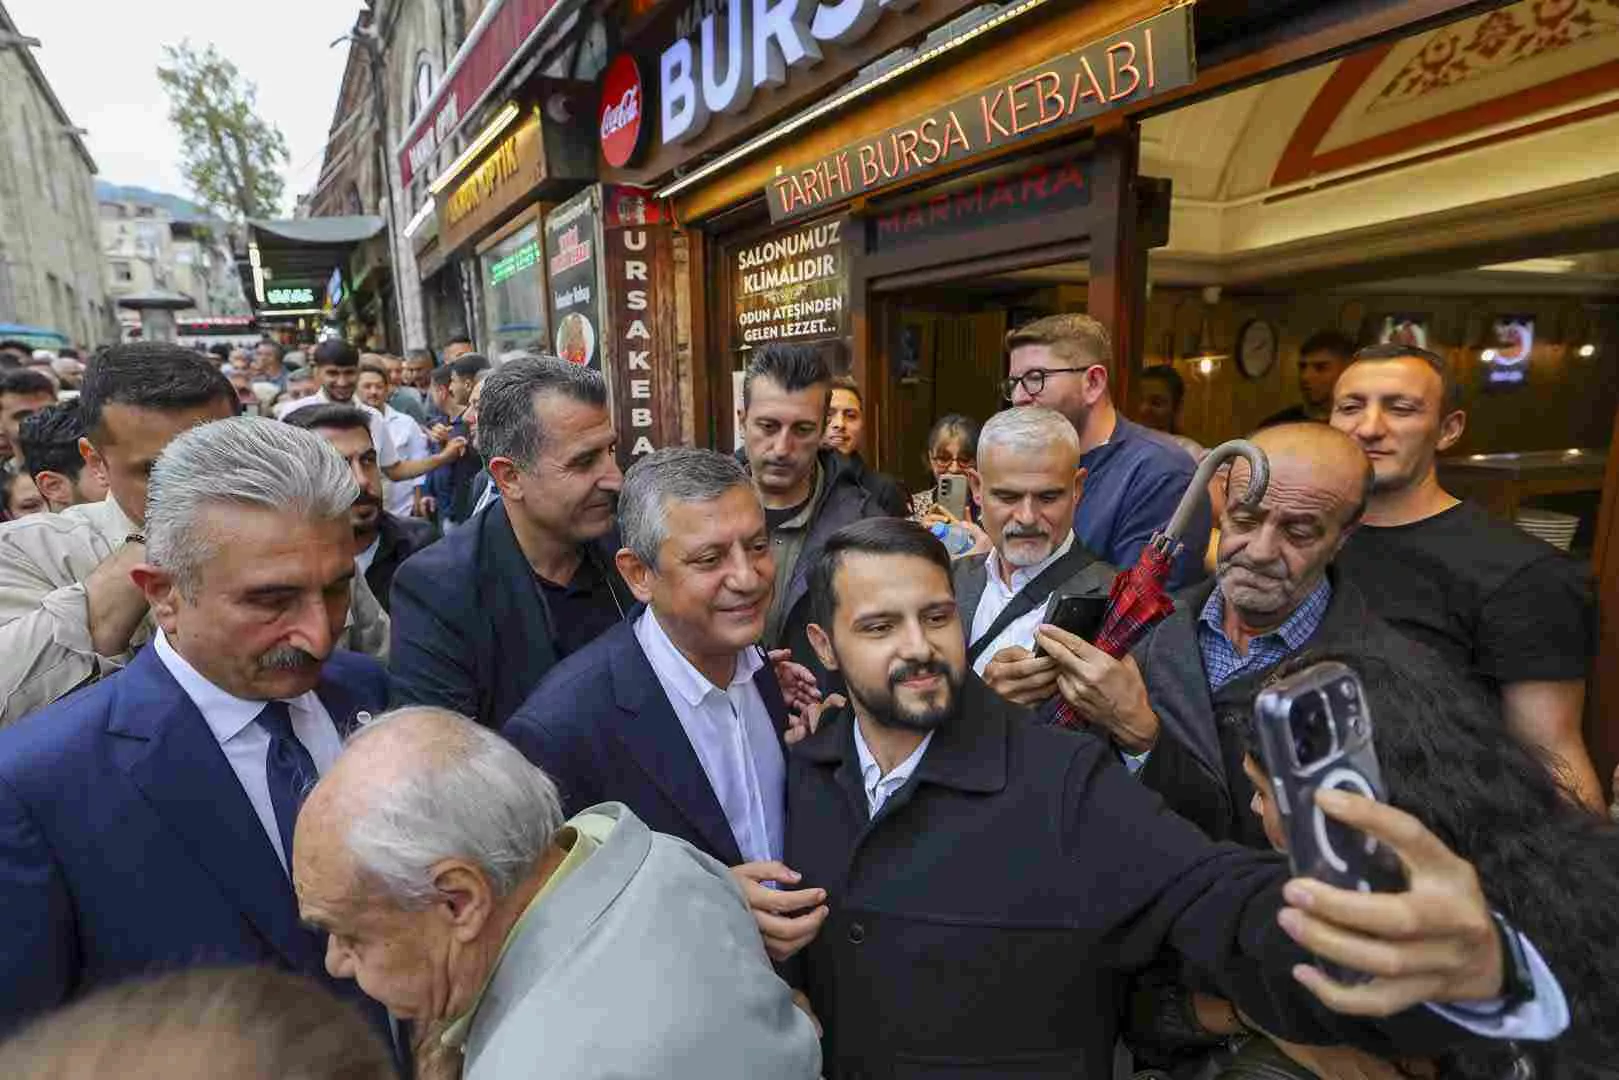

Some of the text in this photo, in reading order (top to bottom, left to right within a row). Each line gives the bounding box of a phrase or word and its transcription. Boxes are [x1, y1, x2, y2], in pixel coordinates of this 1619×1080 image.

[661, 0, 889, 144] BUR
[859, 111, 969, 186] BURSA
[980, 28, 1155, 144] KEBABI
[879, 159, 1084, 232] MARMARA
[738, 221, 840, 271] SALONUMUZ
[743, 254, 835, 294] KLİMALIDIR
[739, 296, 842, 326] ODUN ATEŞİNDEN
[744, 325, 778, 342] GELEN
